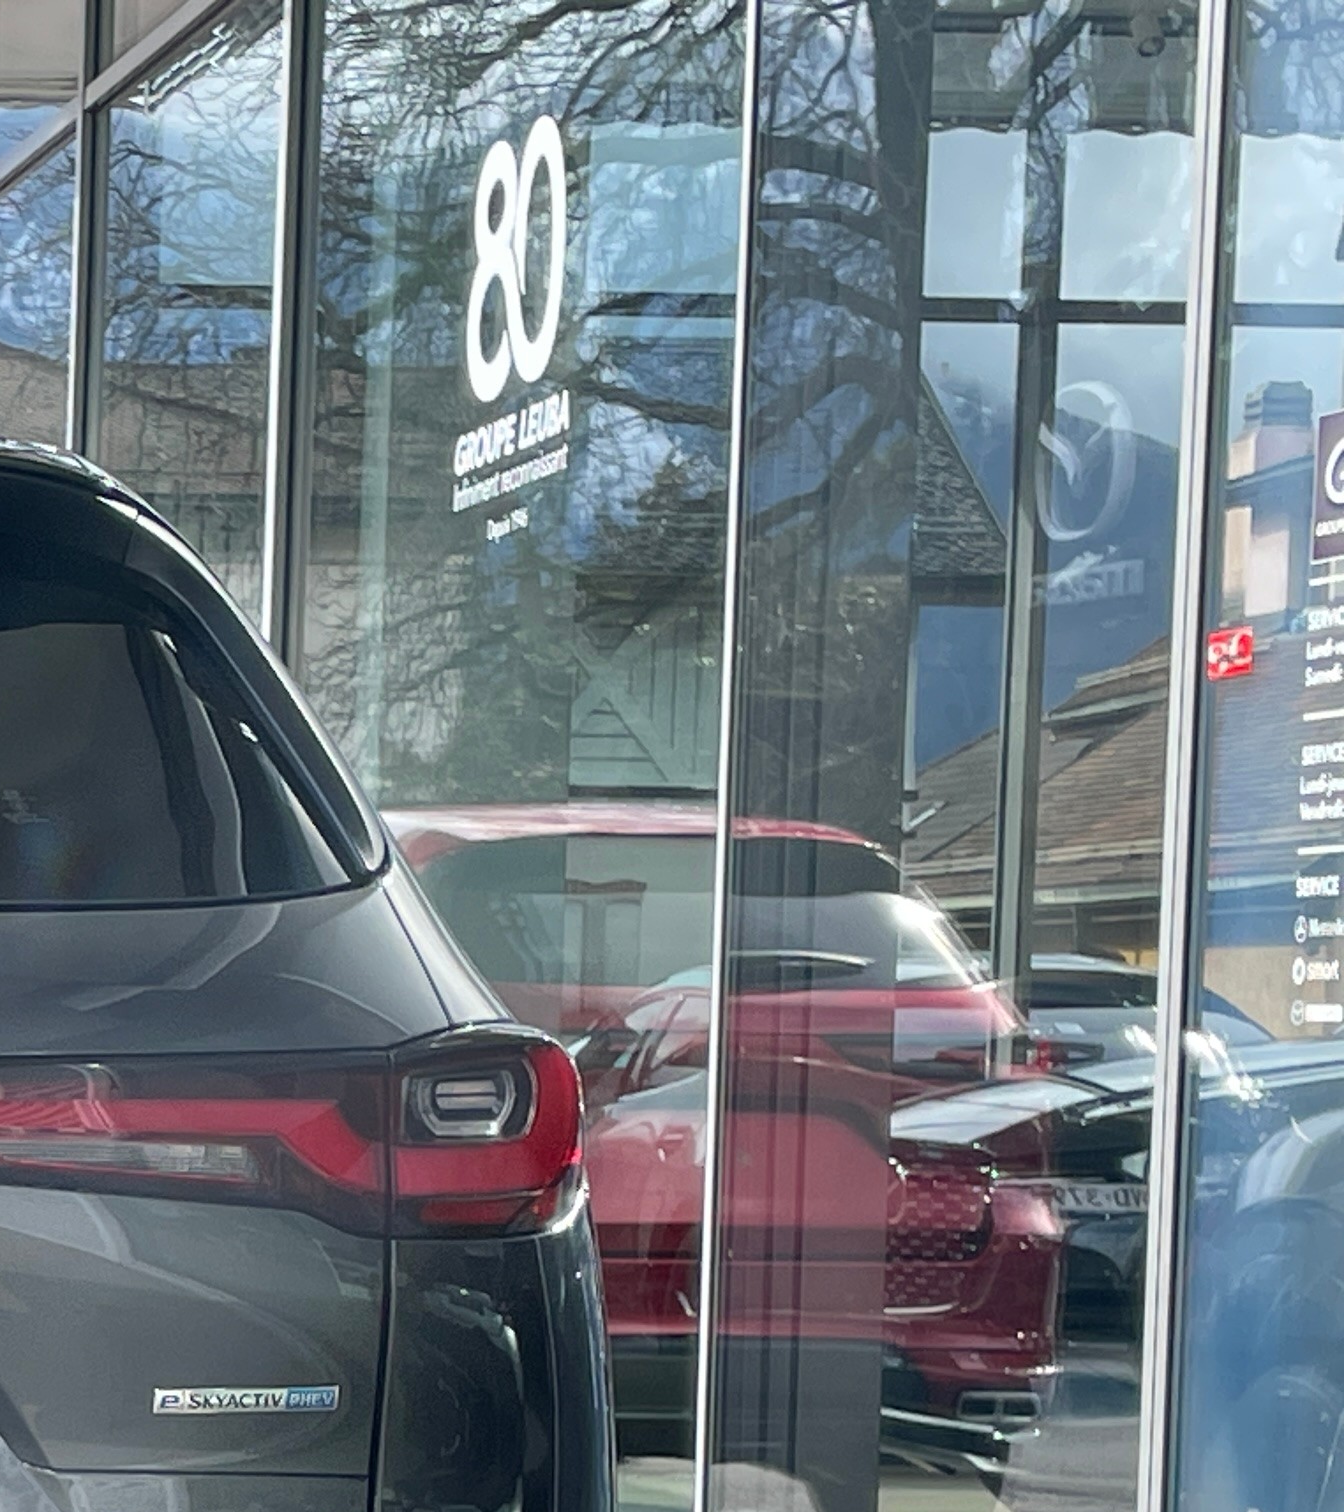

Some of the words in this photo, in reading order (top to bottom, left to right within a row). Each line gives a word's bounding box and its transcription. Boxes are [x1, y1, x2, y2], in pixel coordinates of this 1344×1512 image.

[467, 114, 567, 402] 80
[454, 414, 517, 477] GROUPE
[518, 389, 570, 450] LEUBA
